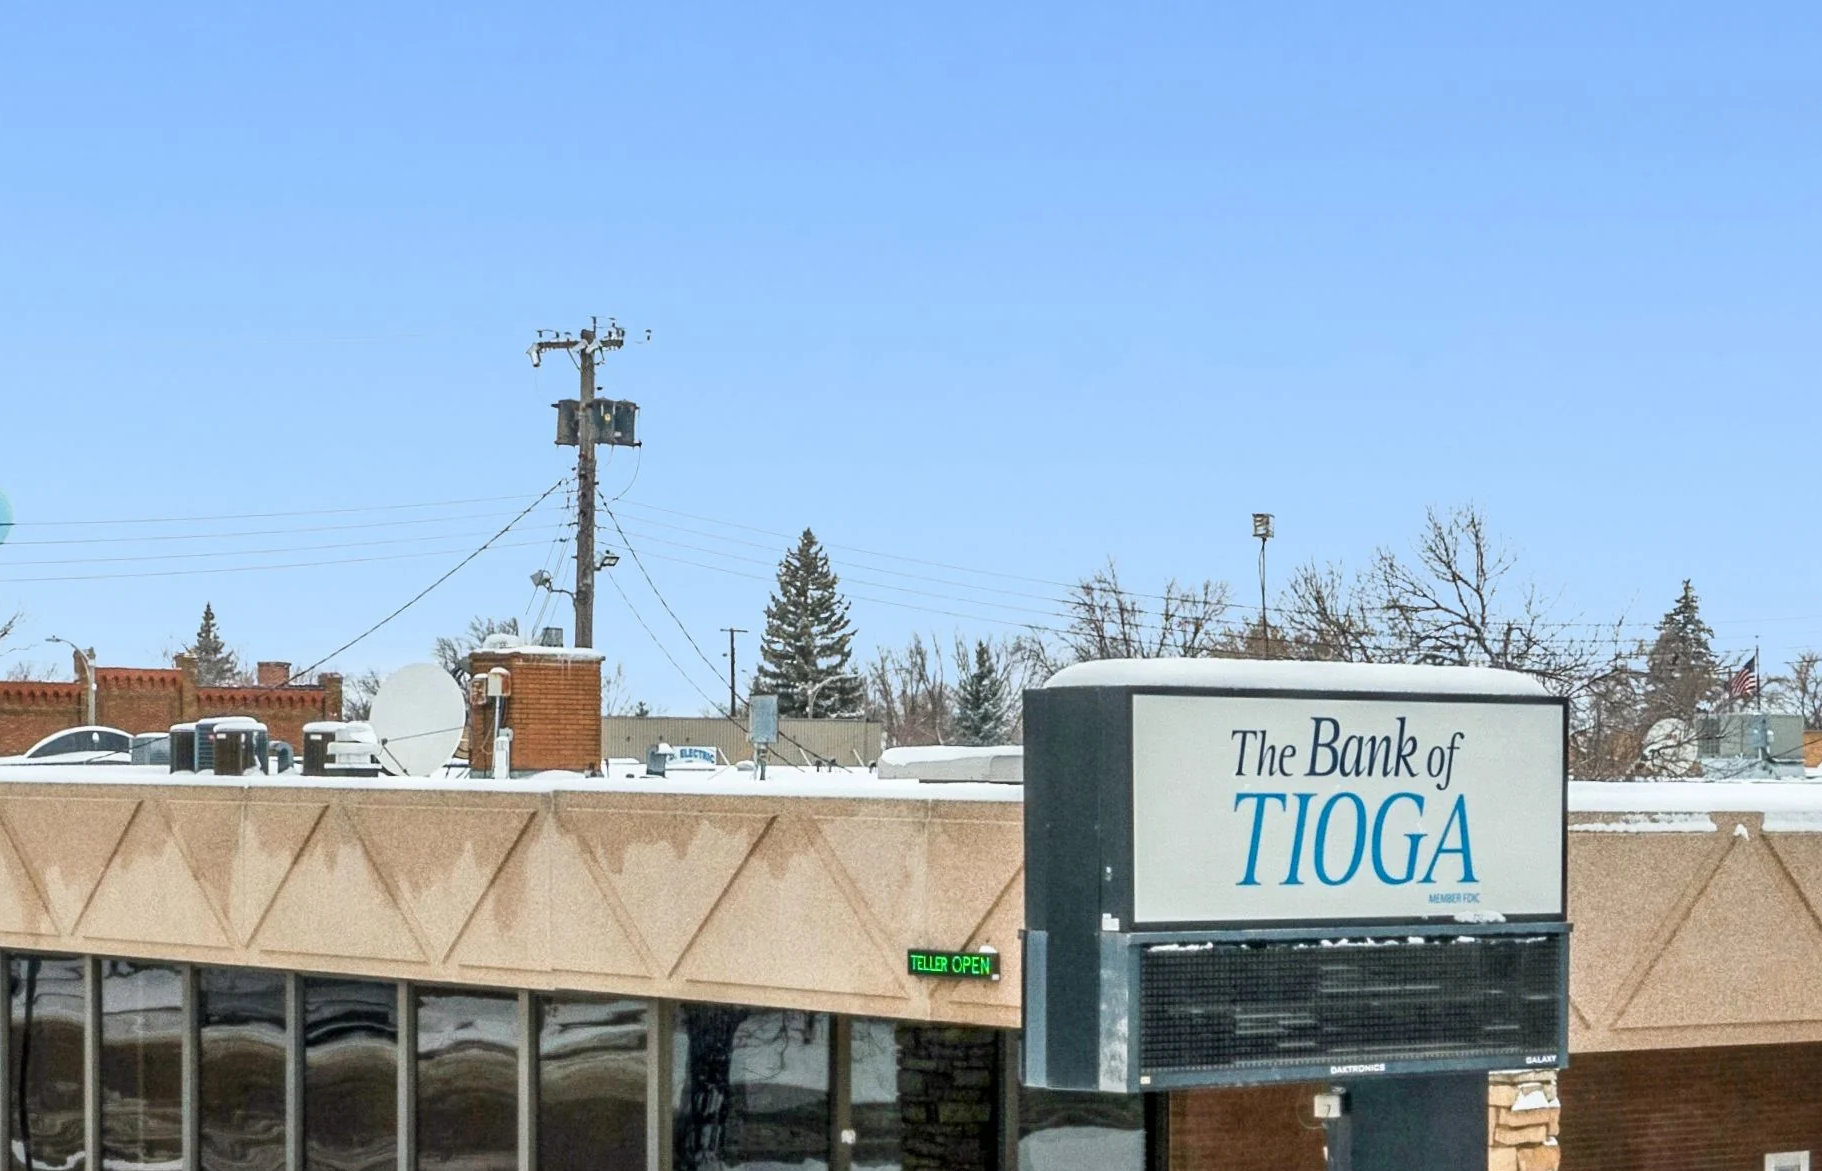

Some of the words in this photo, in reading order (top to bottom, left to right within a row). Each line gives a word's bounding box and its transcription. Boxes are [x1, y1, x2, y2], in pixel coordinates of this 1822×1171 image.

[680, 748, 715, 764] ELECTRIC
[1231, 729, 1297, 777] The
[1303, 716, 1420, 778] Bank
[1426, 731, 1465, 791] of
[1233, 791, 1481, 887] TIOGA
[1428, 893, 1461, 904] MEMBER
[1462, 893, 1481, 904] FDIC
[910, 954, 948, 973] TELLER
[951, 955, 990, 975] OPEN
[1525, 1054, 1557, 1065] GALAXY
[1330, 1063, 1386, 1075] DAKTRONICS
